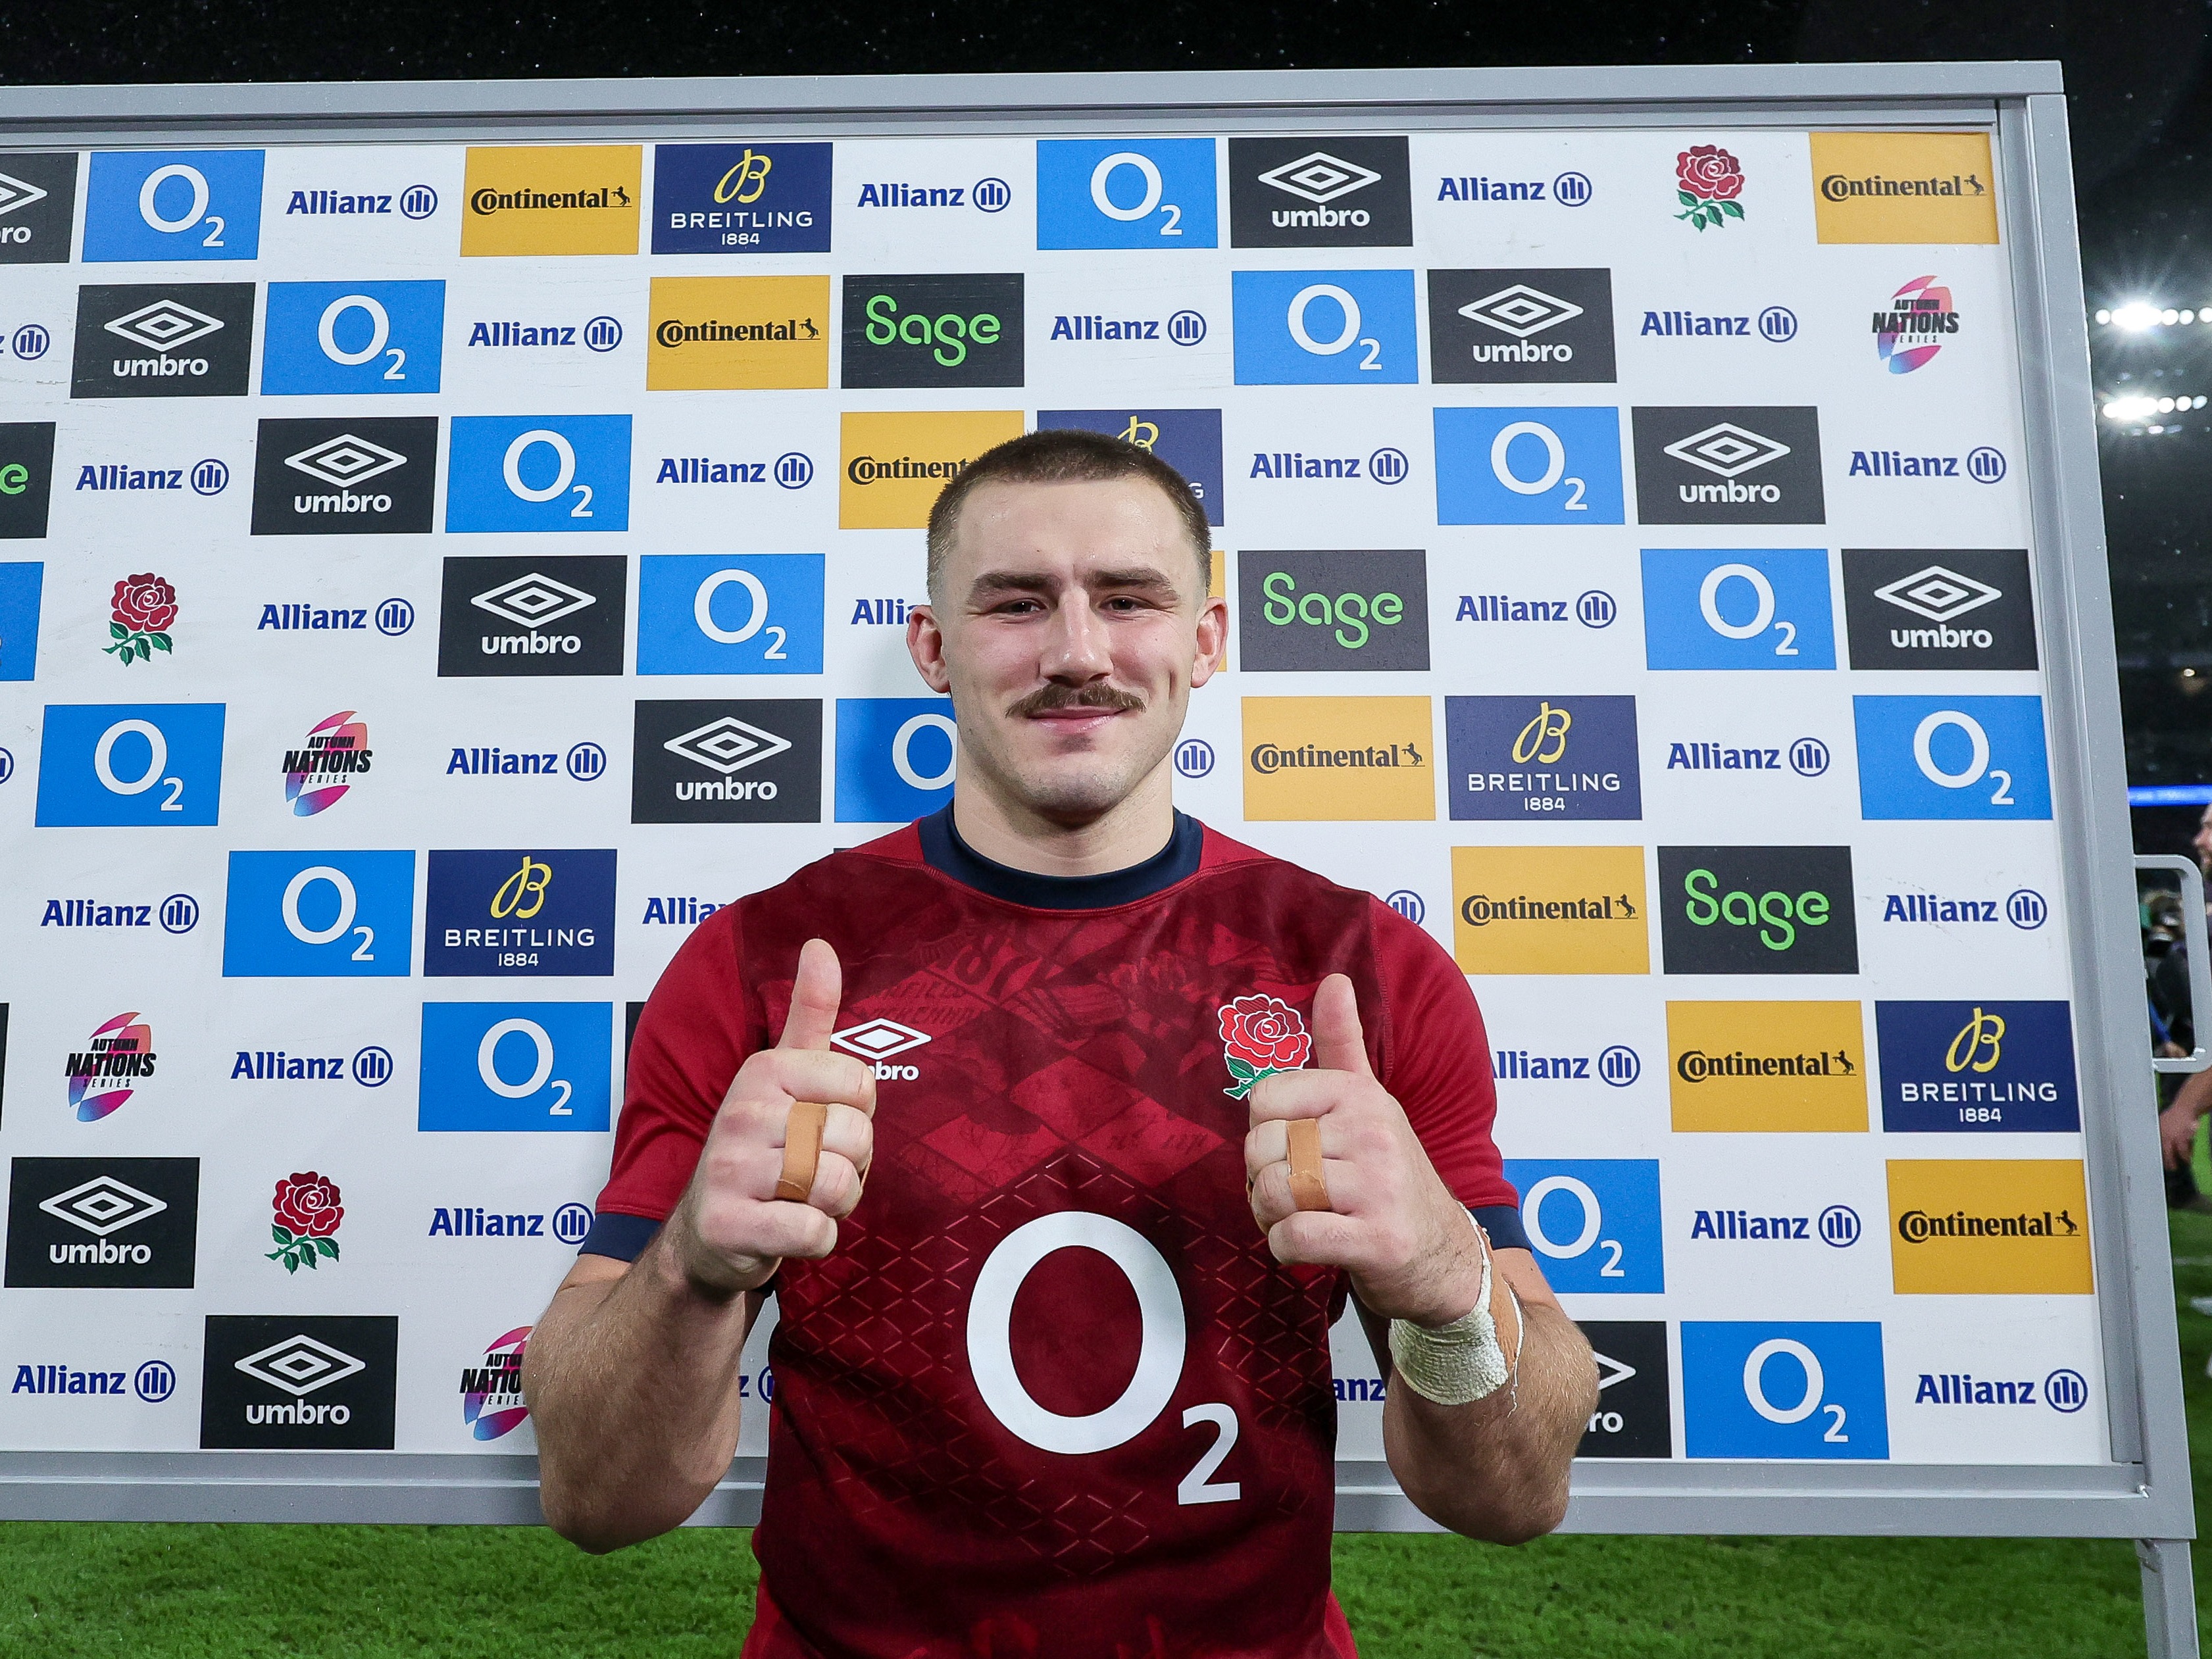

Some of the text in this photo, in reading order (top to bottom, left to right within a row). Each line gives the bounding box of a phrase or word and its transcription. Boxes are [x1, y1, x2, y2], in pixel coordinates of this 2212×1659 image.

[857, 184, 964, 207] Allianz
[1438, 178, 1545, 201] Allianz
[1821, 175, 1963, 202] Continental
[286, 190, 391, 214] Allianz
[471, 188, 609, 215] Continental
[672, 212, 812, 228] BREITLING
[1272, 206, 1370, 227] umbro
[722, 234, 759, 245] 1884
[468, 322, 575, 346] Allianz
[657, 320, 796, 347] Continental
[867, 295, 1000, 366] Sage
[1051, 316, 1159, 340] Allianz
[1641, 311, 1750, 335] Allianz
[1872, 312, 1959, 334] NATIONS
[1473, 340, 1572, 362] umbro
[114, 355, 208, 376] umbro
[657, 458, 765, 483] Allianz
[848, 455, 971, 485] Continen
[1250, 453, 1361, 478] Allianz
[1849, 451, 1959, 476] Allianz
[76, 465, 182, 490] Allianz
[295, 491, 391, 512] umbro
[1680, 480, 1780, 502] umbro
[257, 604, 366, 630] Allianz
[851, 599, 918, 625] Alli
[1264, 572, 1403, 648] Sage
[1456, 595, 1568, 621] Allianz
[482, 631, 580, 654] umbro
[1891, 624, 1992, 647] umbro
[307, 736, 355, 749] AUTUMN
[282, 749, 373, 773] NATIONS
[446, 748, 557, 774] Allianz
[1251, 743, 1399, 774] Continental
[1667, 743, 1780, 769] Allianz
[299, 774, 347, 783] SERIES
[676, 777, 777, 800] umbro
[1469, 774, 1619, 791] BREITLING
[1525, 797, 1565, 810] 1884
[41, 899, 151, 926] Allianz
[642, 897, 726, 924] Allia
[1462, 895, 1613, 926] Continental
[1685, 870, 1829, 950] Sage
[1884, 895, 1998, 922] Allianz
[445, 929, 594, 946] BREITLING
[499, 953, 538, 966] 1884
[65, 1053, 157, 1077] NATIONS
[231, 1052, 343, 1079] Allianz
[868, 1061, 919, 1080] bro
[1491, 1051, 1590, 1078] llianz
[1678, 1051, 1830, 1083] Continental
[83, 1079, 130, 1087] SERIES
[1901, 1083, 2057, 1101] BREITLING
[1960, 1108, 2001, 1122] 1884
[428, 1208, 543, 1236] Allianz
[1692, 1211, 1809, 1239] Allianz
[1899, 1210, 2053, 1243] Continental
[50, 1239, 151, 1264] umbro
[12, 1365, 126, 1394] Allianz
[459, 1369, 521, 1393] NATIO
[1915, 1375, 2036, 1404] Allianz
[247, 1399, 349, 1424] umbro
